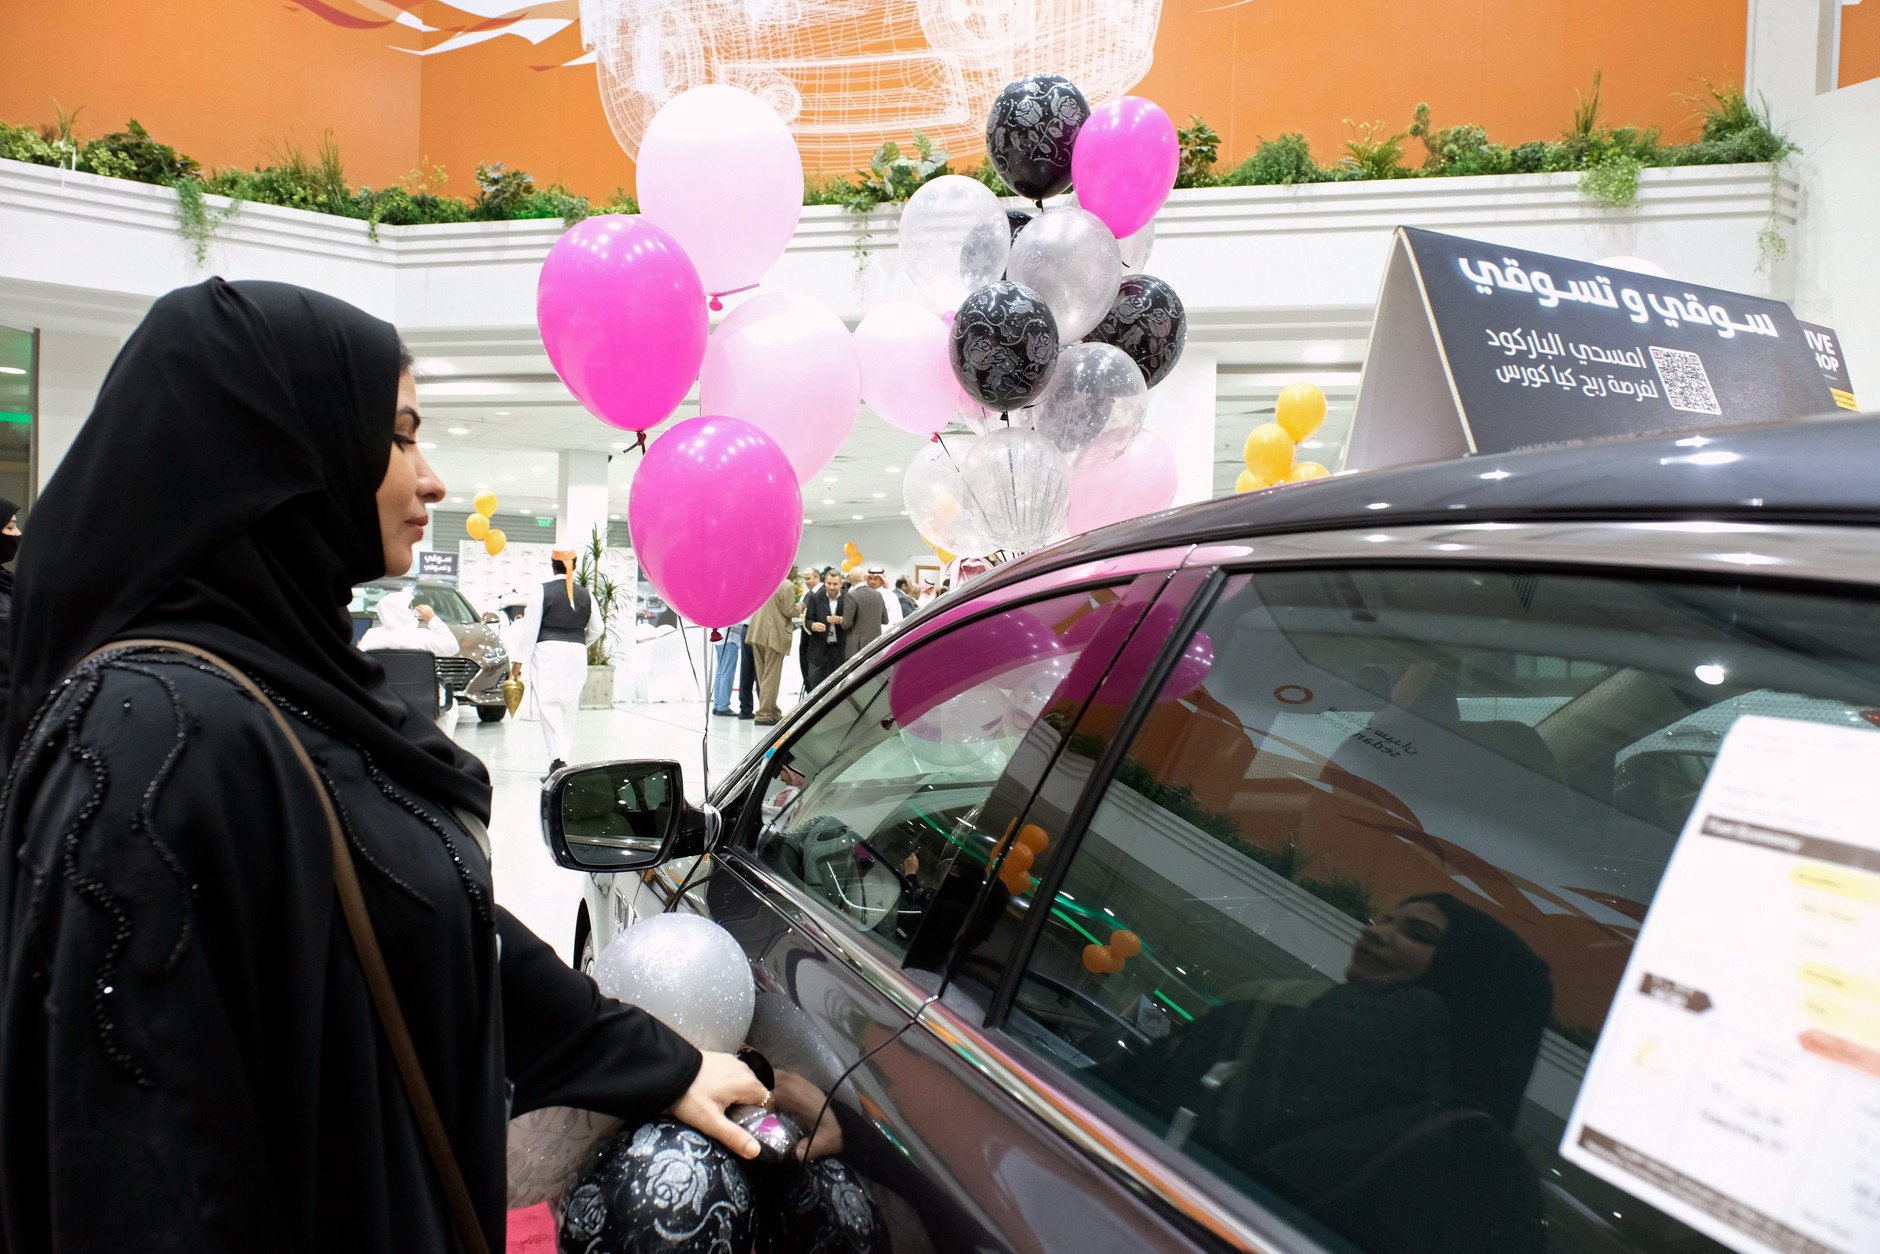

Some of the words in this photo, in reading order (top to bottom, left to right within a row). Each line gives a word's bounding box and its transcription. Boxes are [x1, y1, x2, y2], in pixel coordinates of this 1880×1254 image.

[1647, 292, 1779, 339] سوقي
[1485, 327, 1566, 360] الباركود
[1803, 329, 1836, 355] IVE
[1568, 342, 1648, 369] امسحي
[1815, 352, 1840, 372] HOP
[1495, 363, 1551, 388] كورس
[1550, 365, 1578, 391] كيا
[1579, 374, 1607, 397] ربح
[1606, 373, 1660, 402] لفرصة
